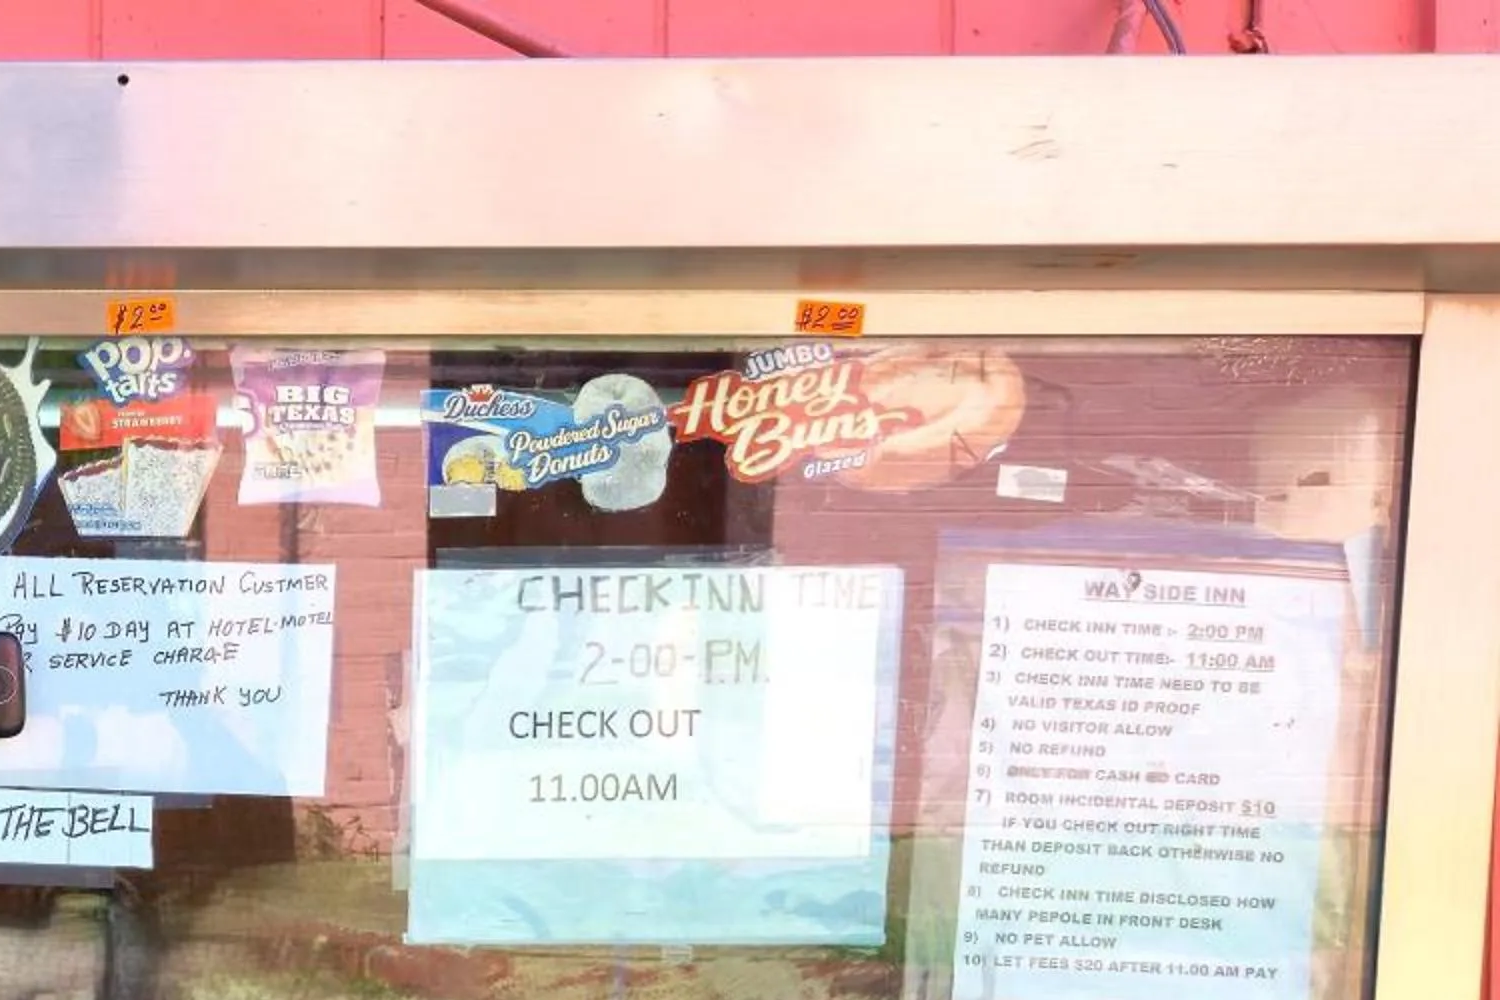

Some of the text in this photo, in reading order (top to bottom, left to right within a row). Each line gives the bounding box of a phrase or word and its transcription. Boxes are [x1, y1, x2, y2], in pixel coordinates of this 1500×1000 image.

[744, 343, 833, 380] JUMBO
[275, 384, 350, 404] BIG
[443, 392, 535, 421] Duchess
[673, 361, 858, 436] Honey
[269, 404, 355, 424] TEXAS
[508, 409, 660, 462] Powdered Sugar
[722, 406, 909, 477] Buns
[527, 443, 613, 484] Donuts
[803, 451, 867, 480] Glazed
[12, 571, 64, 600] ALL
[72, 570, 225, 597] RESERVATION
[793, 573, 881, 610] TIME
[1084, 579, 1246, 604] WAY SIDE INN
[56, 616, 196, 644] $10 DAY AT
[1024, 617, 1082, 633] CHECK
[1086, 620, 1118, 635] INN
[1122, 622, 1163, 637] TIME
[1187, 623, 1228, 640] 2:00
[1235, 625, 1264, 641] PM
[49, 651, 133, 669] SERVICE
[153, 642, 241, 665] CHARGE
[988, 644, 1276, 670] 2) CHECK OUT 11:00 AM
[160, 685, 283, 707] THANK YOU
[1014, 671, 1072, 686] CHECK
[1077, 673, 1110, 688] INN
[1115, 675, 1155, 690] TIME
[1159, 677, 1205, 692] NEED
[1211, 679, 1233, 694] TO
[1237, 680, 1261, 695] BE
[1007, 695, 1201, 716] VALID TEXAS ID PROOF
[508, 708, 702, 740] CHECK OUT
[1011, 718, 1038, 732] NO
[1041, 719, 1110, 735] VISITOR
[1113, 722, 1174, 738] ALLOW
[1008, 742, 1034, 756] NO
[1037, 743, 1106, 758] REFUND
[528, 773, 679, 804] 11.00AM
[1095, 769, 1140, 783] CASH
[1175, 772, 1221, 787] CARD
[1004, 791, 1054, 804] ROOM
[1059, 793, 1158, 811] INCIDENTAL
[1163, 797, 1237, 814] DEPOSIT
[1240, 799, 1277, 817] $10
[62, 803, 150, 838] BELL
[1002, 816, 1262, 840] IF YOU CHECK OUT RIGHT TIME
[980, 839, 1285, 865] THAN DEPOSIT BACK OTHERWISE NO
[978, 862, 1046, 878] REFUND
[997, 885, 1056, 902] CHECK
[1059, 888, 1091, 903] INN
[1095, 890, 1135, 905] TIME
[1138, 892, 1232, 909] DISCLOSED
[1236, 896, 1277, 911] HOW
[974, 908, 1224, 932] MANY PEPOLE IN FRONT DESK
[994, 932, 1019, 946] NO
[1022, 933, 1056, 948] PET
[1058, 935, 1118, 950] ALLOW
[993, 954, 1024, 968] LET
[1028, 956, 1070, 971] FEES
[1074, 958, 1104, 973] $20
[1107, 960, 1164, 976] AFTER
[1166, 962, 1210, 977] 11.00
[1213, 964, 1240, 979] AM
[1244, 966, 1279, 981] PAY
